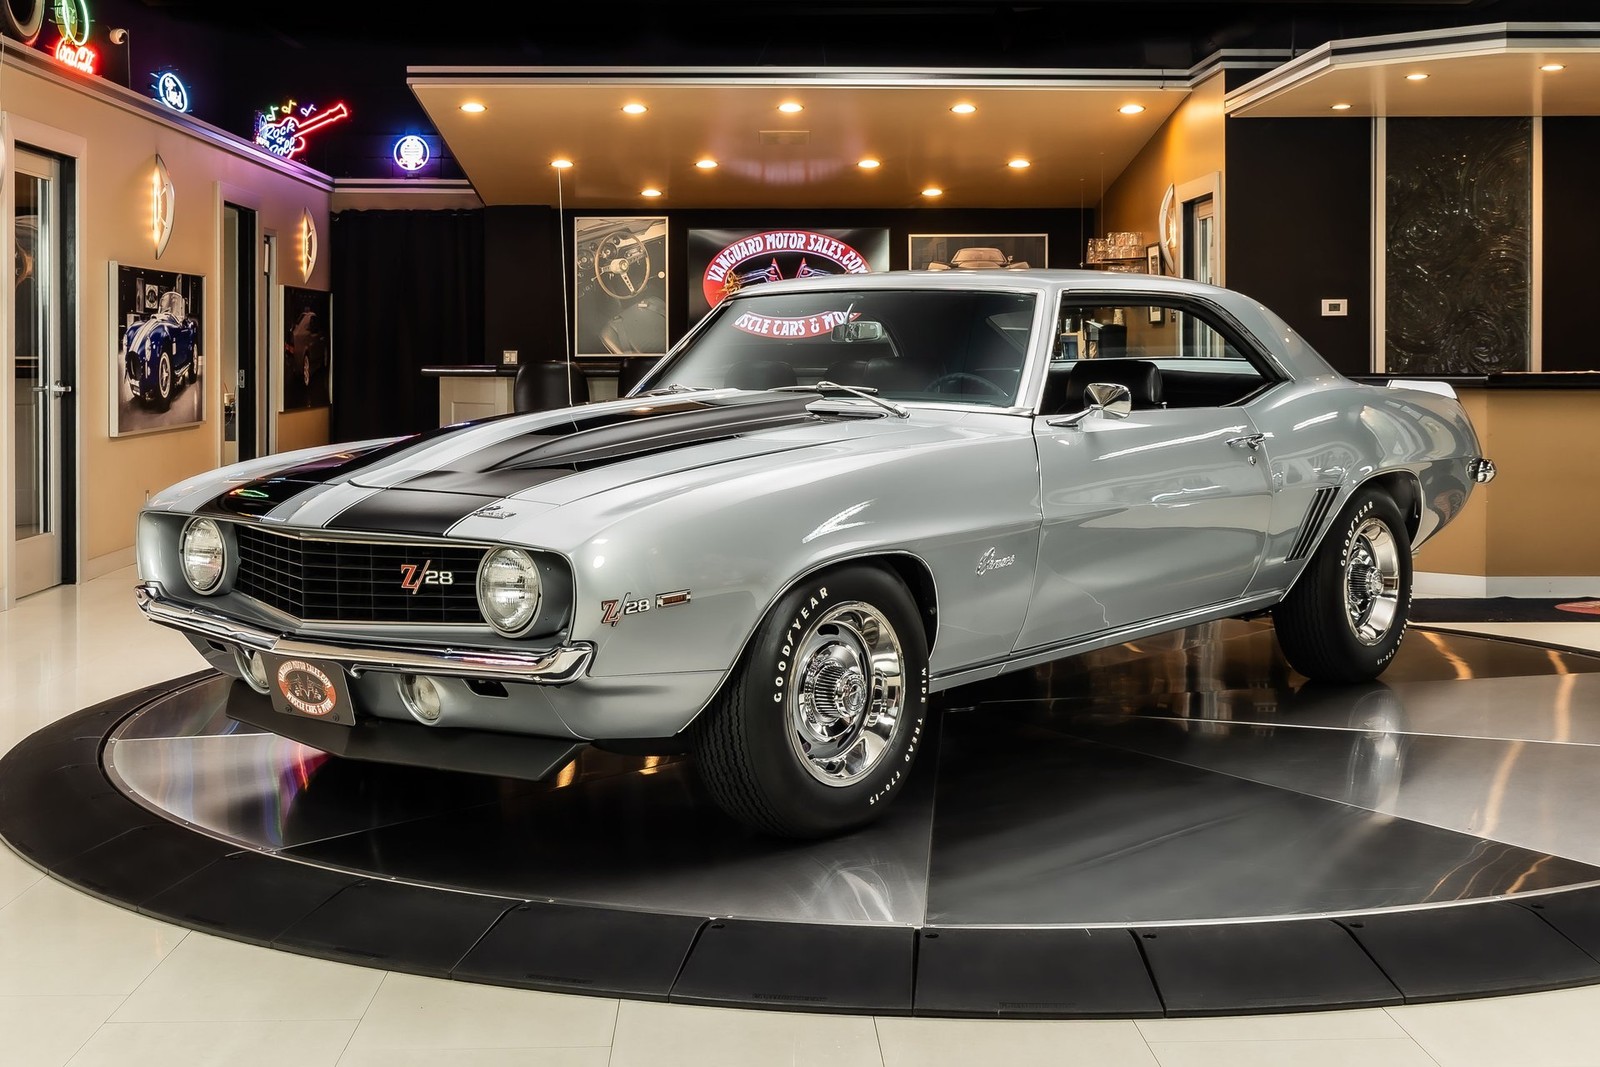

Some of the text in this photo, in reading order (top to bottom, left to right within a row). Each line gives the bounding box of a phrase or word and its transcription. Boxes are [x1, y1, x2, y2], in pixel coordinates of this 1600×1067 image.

[265, 119, 295, 140] Rock
[707, 236, 764, 283] VANGUARD
[765, 232, 807, 250] MOTOR
[734, 311, 858, 336] USCLE CARS & MO
[400, 559, 454, 595] Z/28
[600, 592, 650, 628] Z/28
[773, 587, 828, 703] GOODYEAR
[920, 667, 928, 704] WIDE
[904, 718, 923, 763] TREAD
